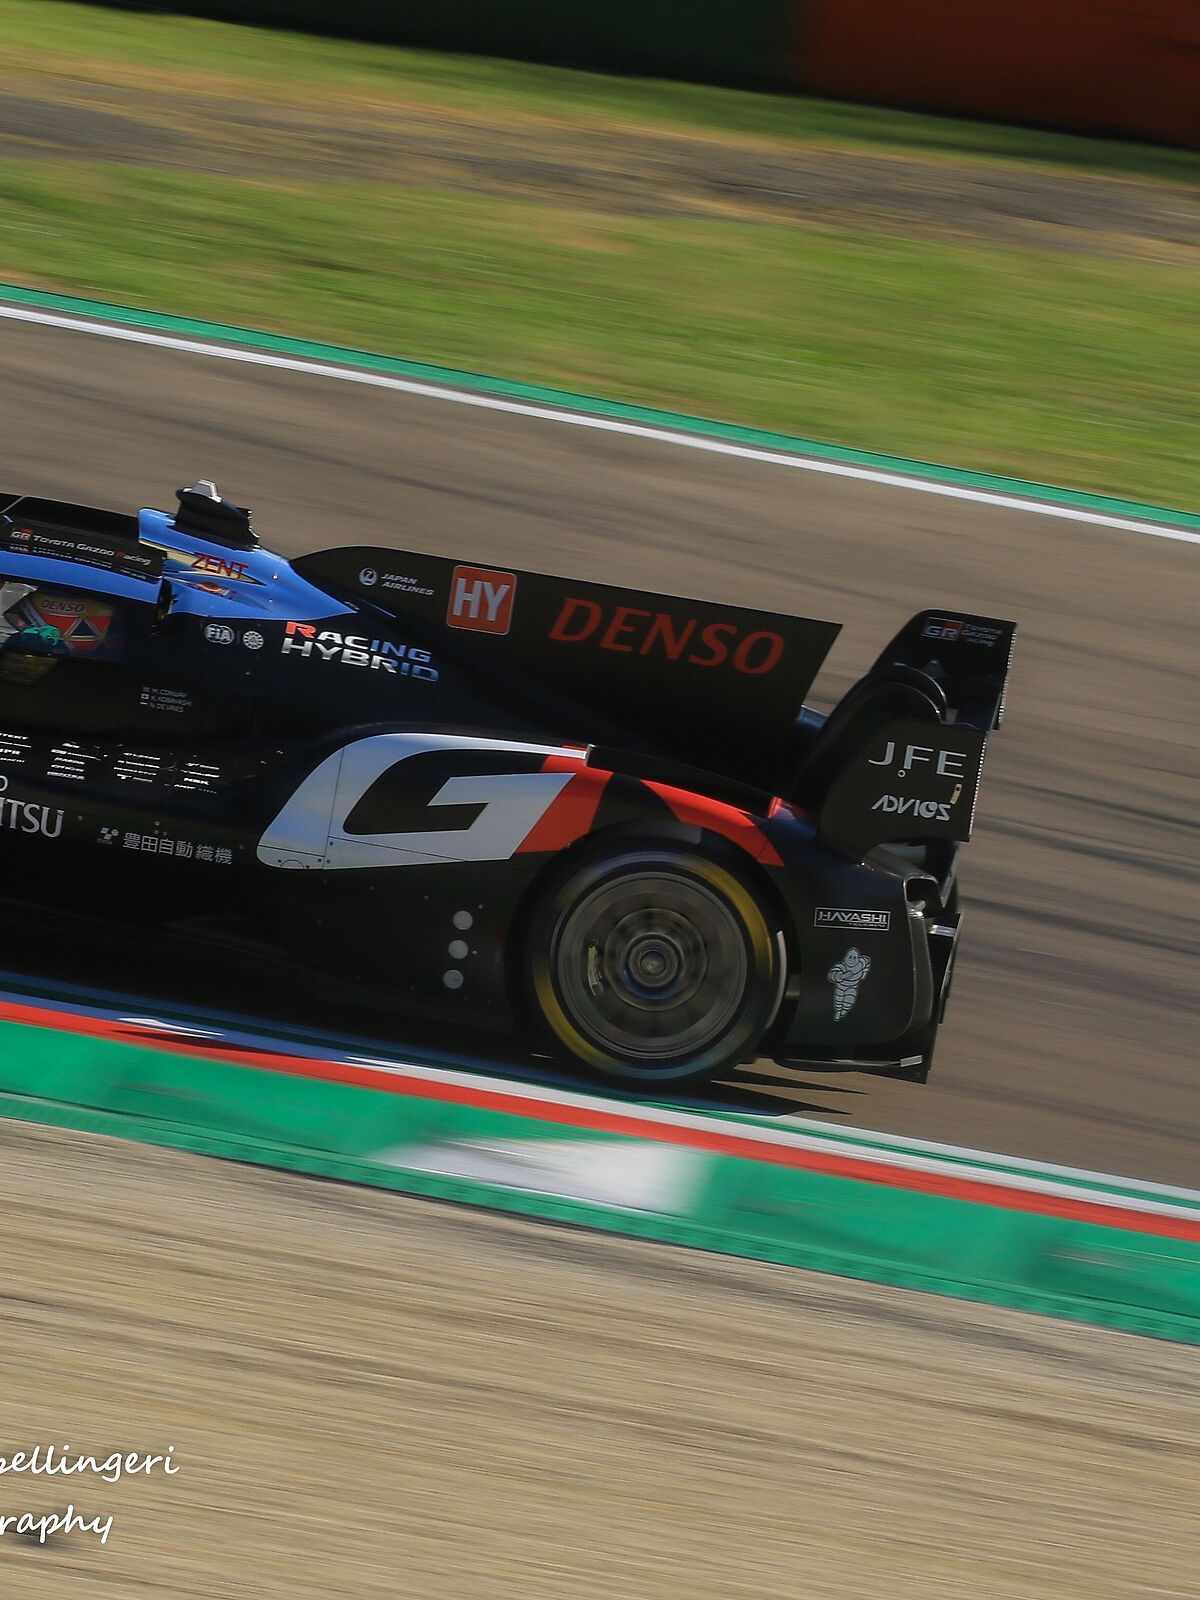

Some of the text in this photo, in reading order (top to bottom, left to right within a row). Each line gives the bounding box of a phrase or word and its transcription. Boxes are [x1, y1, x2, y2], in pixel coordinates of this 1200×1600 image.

[32, 534, 76, 549] TOYOTA
[191, 552, 249, 579] ZENT
[380, 572, 418, 585] JAPAN
[381, 581, 436, 597] AIRLINES
[452, 577, 510, 622] HY
[40, 599, 86, 613] DENSO
[284, 620, 432, 664] RACING
[548, 597, 785, 675] DENSO
[280, 637, 440, 682] HYBRID
[868, 741, 968, 779] JFE
[122, 832, 233, 865] 豊田自動織機
[817, 911, 887, 924] HAYASHI
